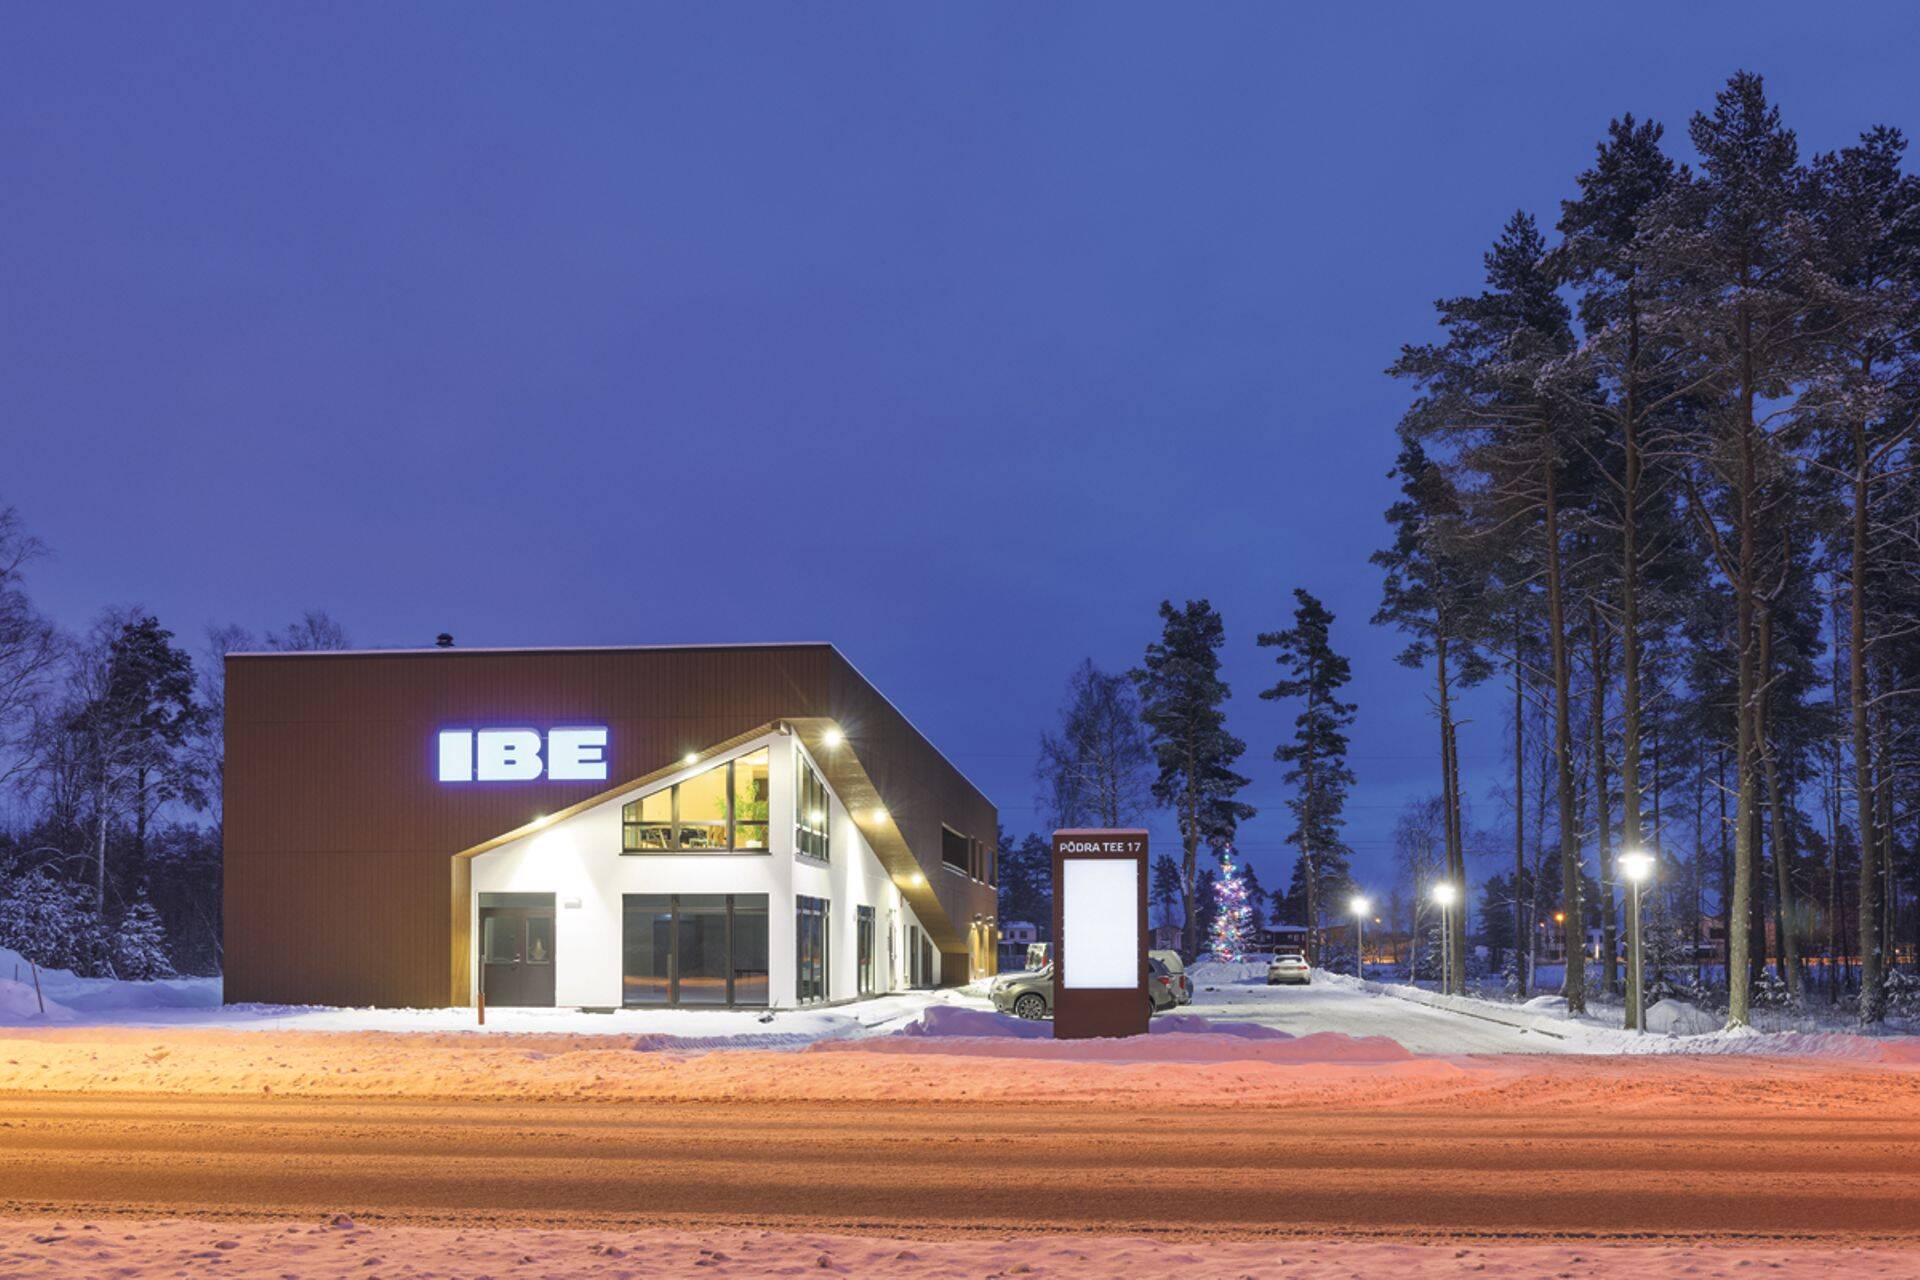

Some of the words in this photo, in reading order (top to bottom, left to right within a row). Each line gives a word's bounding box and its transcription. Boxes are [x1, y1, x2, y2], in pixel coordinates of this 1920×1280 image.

[439, 727, 607, 781] IBE
[1103, 842, 1124, 852] TEE
[1127, 842, 1141, 852] 17
